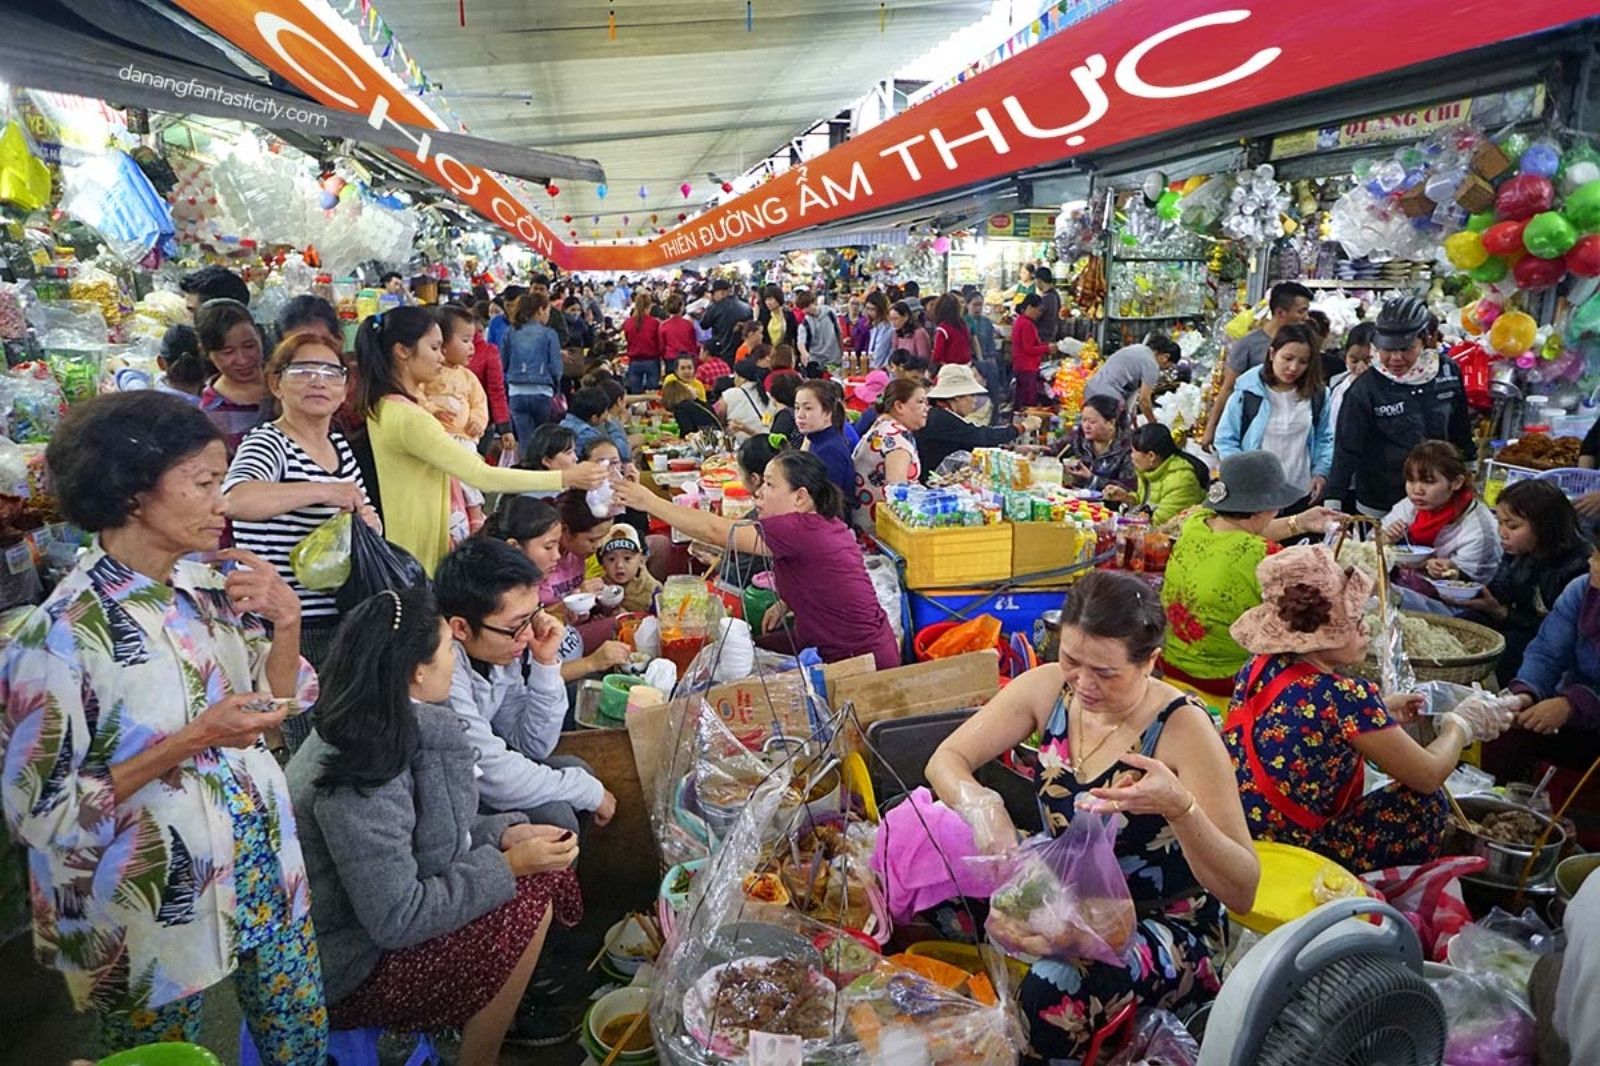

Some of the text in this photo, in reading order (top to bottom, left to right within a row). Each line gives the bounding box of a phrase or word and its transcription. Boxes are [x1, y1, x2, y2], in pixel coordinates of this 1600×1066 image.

[253, 11, 481, 195] CHỢ
[659, 232, 699, 259] THIÊN
[699, 197, 789, 247] ĐƯỜNG
[796, 161, 874, 217] ẨM
[879, 9, 1283, 181] THỰC
